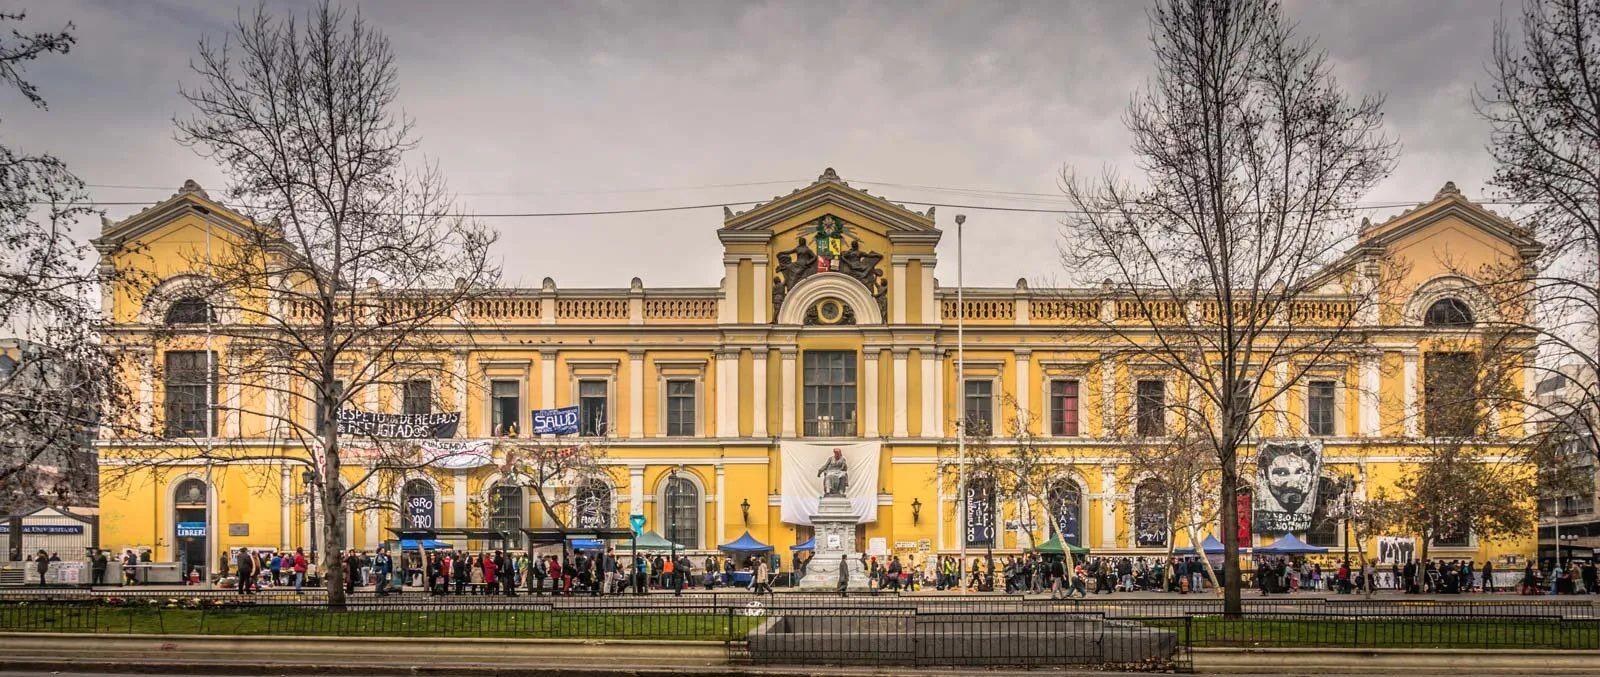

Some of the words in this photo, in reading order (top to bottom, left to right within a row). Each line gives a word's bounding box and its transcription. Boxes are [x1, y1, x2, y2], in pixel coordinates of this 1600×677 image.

[399, 412, 458, 425] DERECHOS
[534, 412, 577, 430] SALUD
[967, 488, 975, 542] DERECHO
